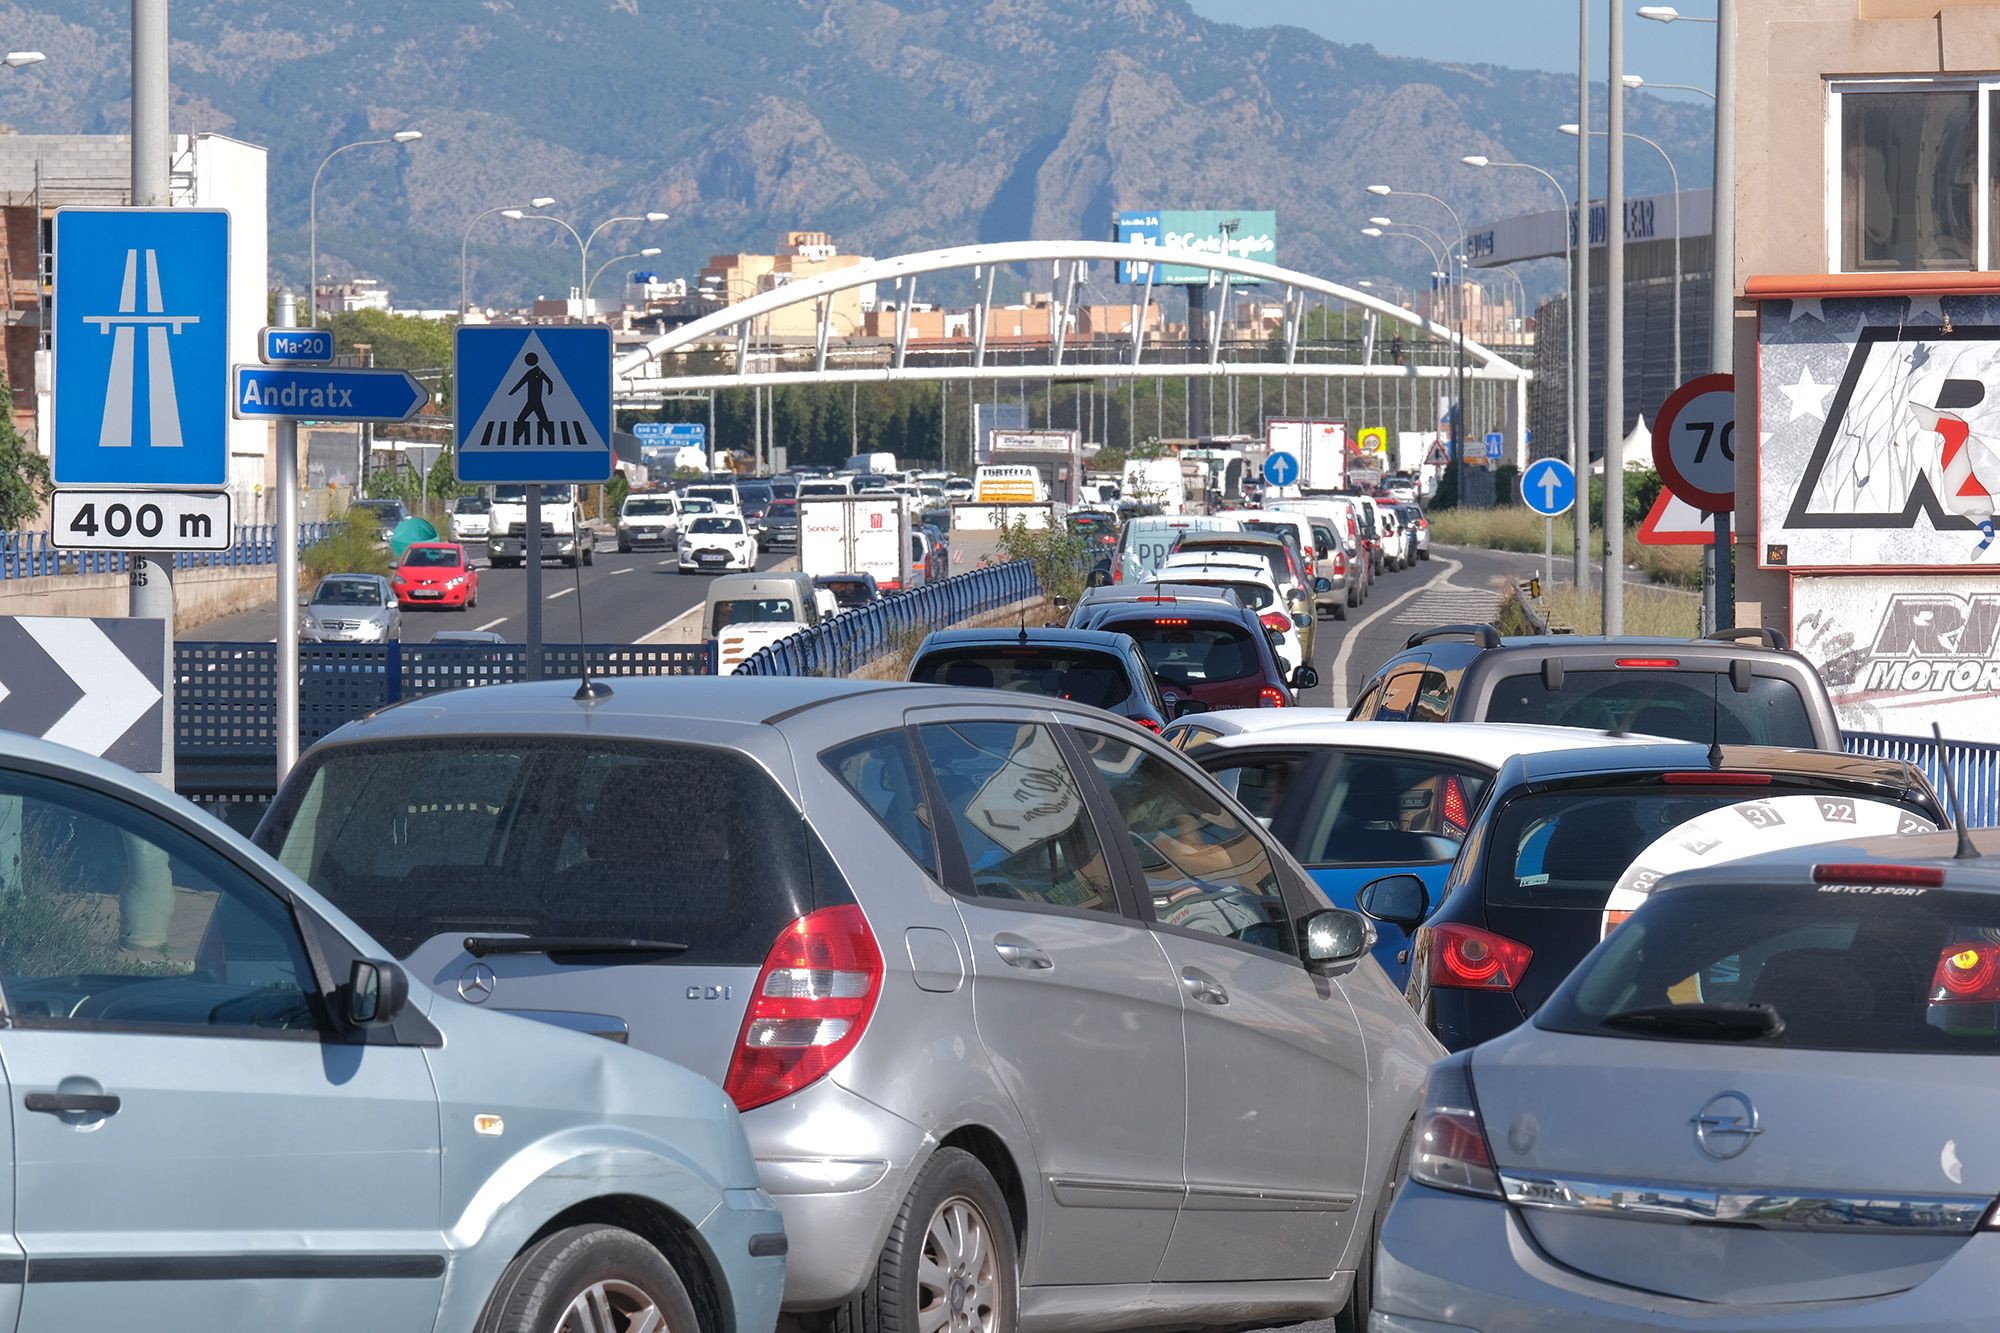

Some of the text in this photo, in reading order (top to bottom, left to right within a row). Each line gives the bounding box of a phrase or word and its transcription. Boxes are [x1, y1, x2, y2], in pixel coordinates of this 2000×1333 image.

[275, 338, 324, 354] Ma-20
[242, 379, 353, 408] Andratx
[69, 503, 212, 538] 400 m
[130, 572, 148, 587] 25
[1746, 805, 1779, 826] 31
[1822, 802, 1855, 821] 22
[1818, 884, 1928, 897] MEYCO SPORT
[686, 985, 732, 1001] CDI
